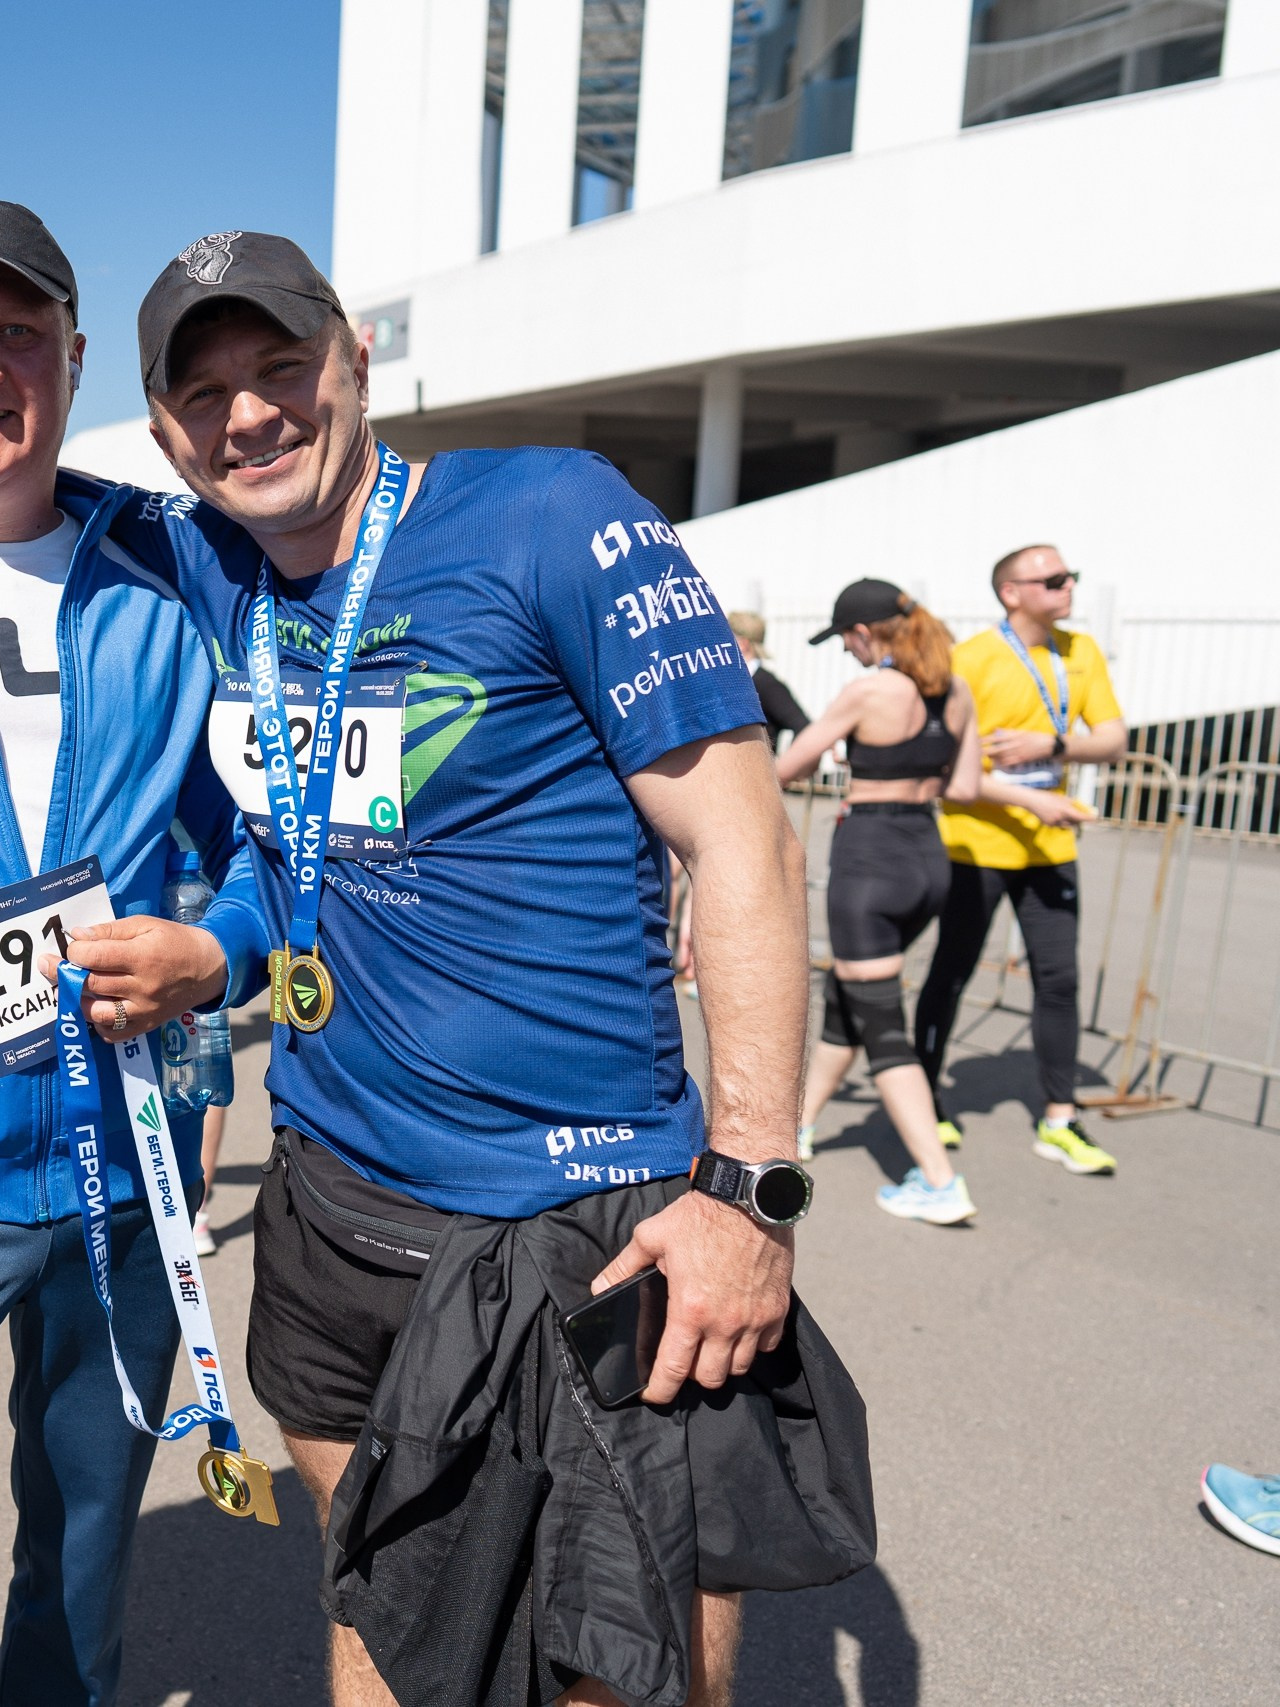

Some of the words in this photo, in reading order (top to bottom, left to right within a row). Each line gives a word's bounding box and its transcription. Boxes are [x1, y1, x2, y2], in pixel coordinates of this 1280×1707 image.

[382, 446, 403, 477] ГО
[363, 478, 399, 543] ЭТОТ
[329, 548, 375, 673] МЕНЯЮТ
[253, 600, 278, 711] МЕНЯЮТ
[243, 714, 368, 779] 520
[314, 680, 340, 774] ГЕРОИ
[262, 717, 291, 790] ЭТОТ
[302, 814, 323, 859] КМ
[375, 841, 394, 850] ПСБ
[300, 865, 316, 894] 10
[382, 891, 420, 905] 2024
[61, 1012, 80, 1038] 10
[64, 1044, 90, 1087] КМ
[580, 1123, 635, 1147] ПСБ
[75, 1124, 106, 1218] ГЕРОИ
[369, 1239, 404, 1255] Kalenji
[203, 1372, 224, 1412] ПСБ
[158, 1407, 212, 1438] РОД
